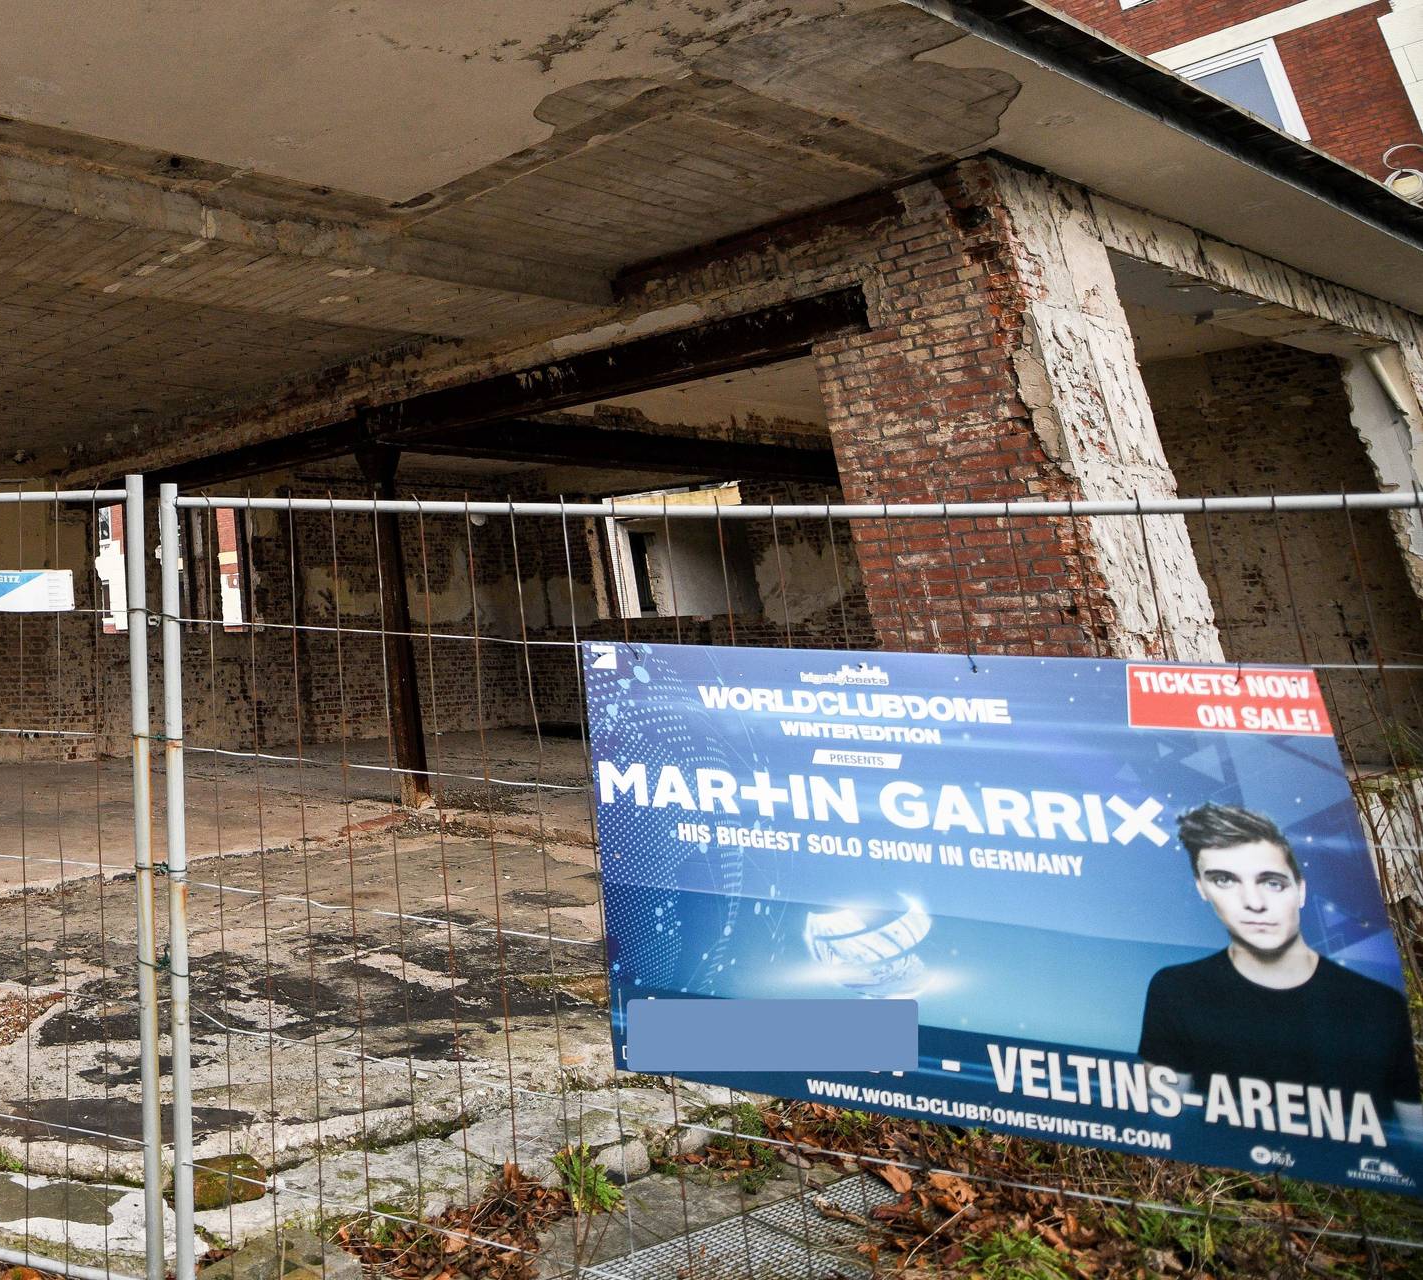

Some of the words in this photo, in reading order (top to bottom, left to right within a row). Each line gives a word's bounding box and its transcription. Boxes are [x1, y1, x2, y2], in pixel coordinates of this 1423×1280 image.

[1133, 671, 1241, 697] TICKETS
[1244, 675, 1310, 699] NOW
[1196, 704, 1237, 728] ON
[1240, 706, 1321, 732] SALE!
[829, 752, 884, 767] PRESENTS
[879, 781, 1170, 848] GARRIX
[677, 823, 711, 844] HIS
[716, 825, 801, 852] BIGGEST
[808, 835, 864, 858] SOLO
[868, 838, 932, 864] SHOW
[938, 844, 964, 866] IN
[969, 846, 1083, 877] GERMANY
[806, 1078, 1171, 1151] WWW.WORLDCLUBDOMEWINTER.COM
[986, 1043, 1388, 1148] VELTINS-ARENA
